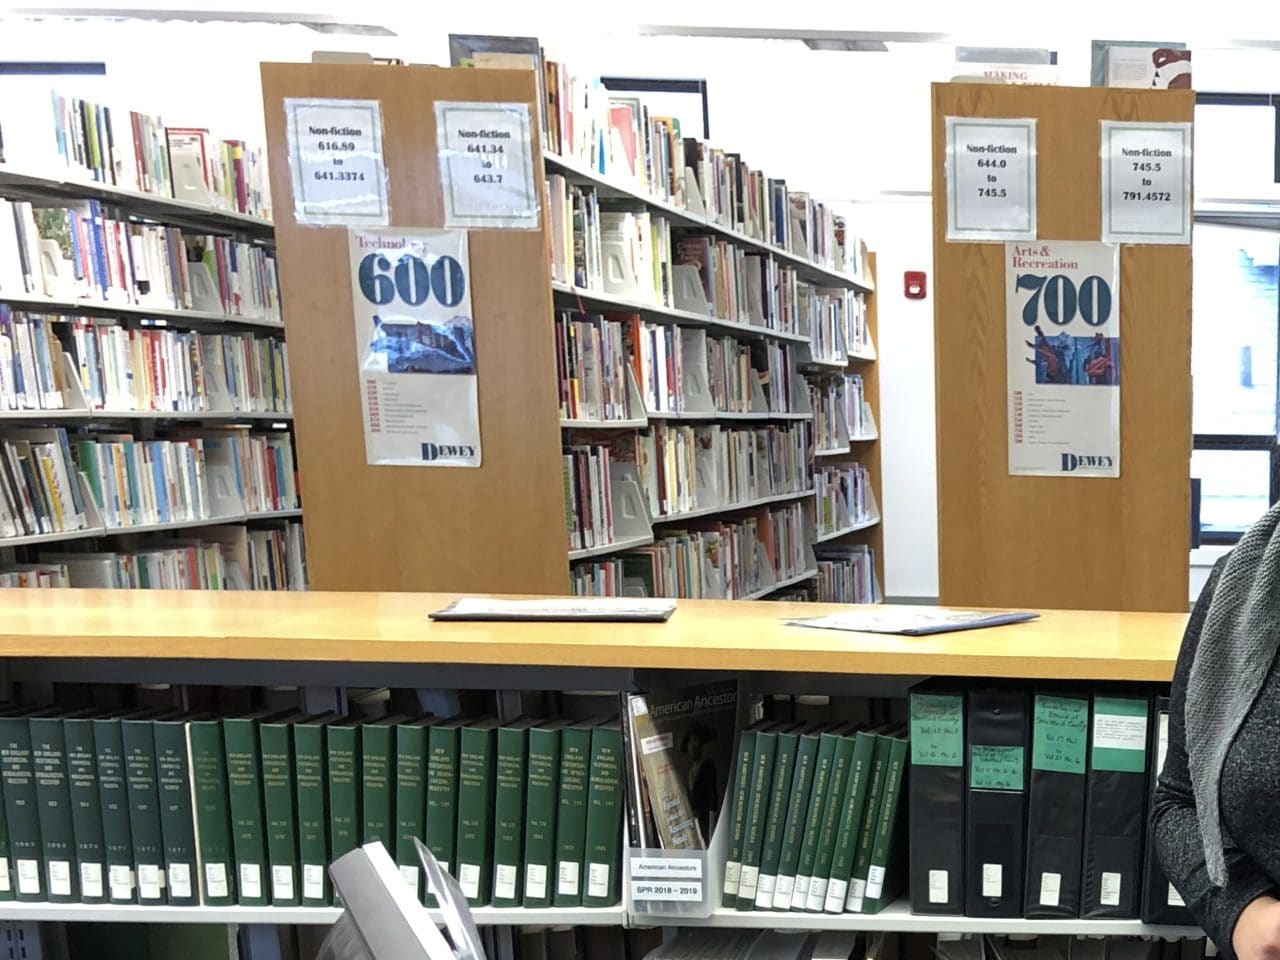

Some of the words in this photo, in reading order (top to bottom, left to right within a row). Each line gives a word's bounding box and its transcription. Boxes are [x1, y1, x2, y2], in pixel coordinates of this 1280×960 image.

[984, 71, 1028, 80] MAKING
[308, 126, 362, 137] Non-fiction
[458, 129, 511, 139] Non-fiction
[467, 144, 504, 153] 641.34
[966, 144, 1017, 154] Non-fiction
[1122, 148, 1172, 158] Non-fiction
[333, 157, 343, 166] to
[977, 159, 1007, 169] 644.0
[1132, 163, 1161, 172] 745.5
[314, 171, 365, 182] 641.3374
[473, 174, 503, 183] 643.7
[987, 174, 997, 183] to
[1142, 177, 1152, 186] to
[978, 188, 1007, 198] 745.5
[1123, 192, 1171, 201] 791.4572
[1012, 246, 1038, 257] Arts
[1040, 246, 1050, 257] &
[1012, 257, 1078, 270] Recreation
[358, 253, 465, 307] 600
[1015, 273, 1112, 326] 700
[421, 443, 476, 461] DEWEY
[1061, 453, 1113, 471] DEWEY
[650, 703, 692, 718] American
[638, 863, 666, 872] American
[667, 863, 697, 872] Ancestors
[637, 886, 652, 894] SPR
[654, 887, 672, 895] 2018
[679, 887, 698, 895] 2019
